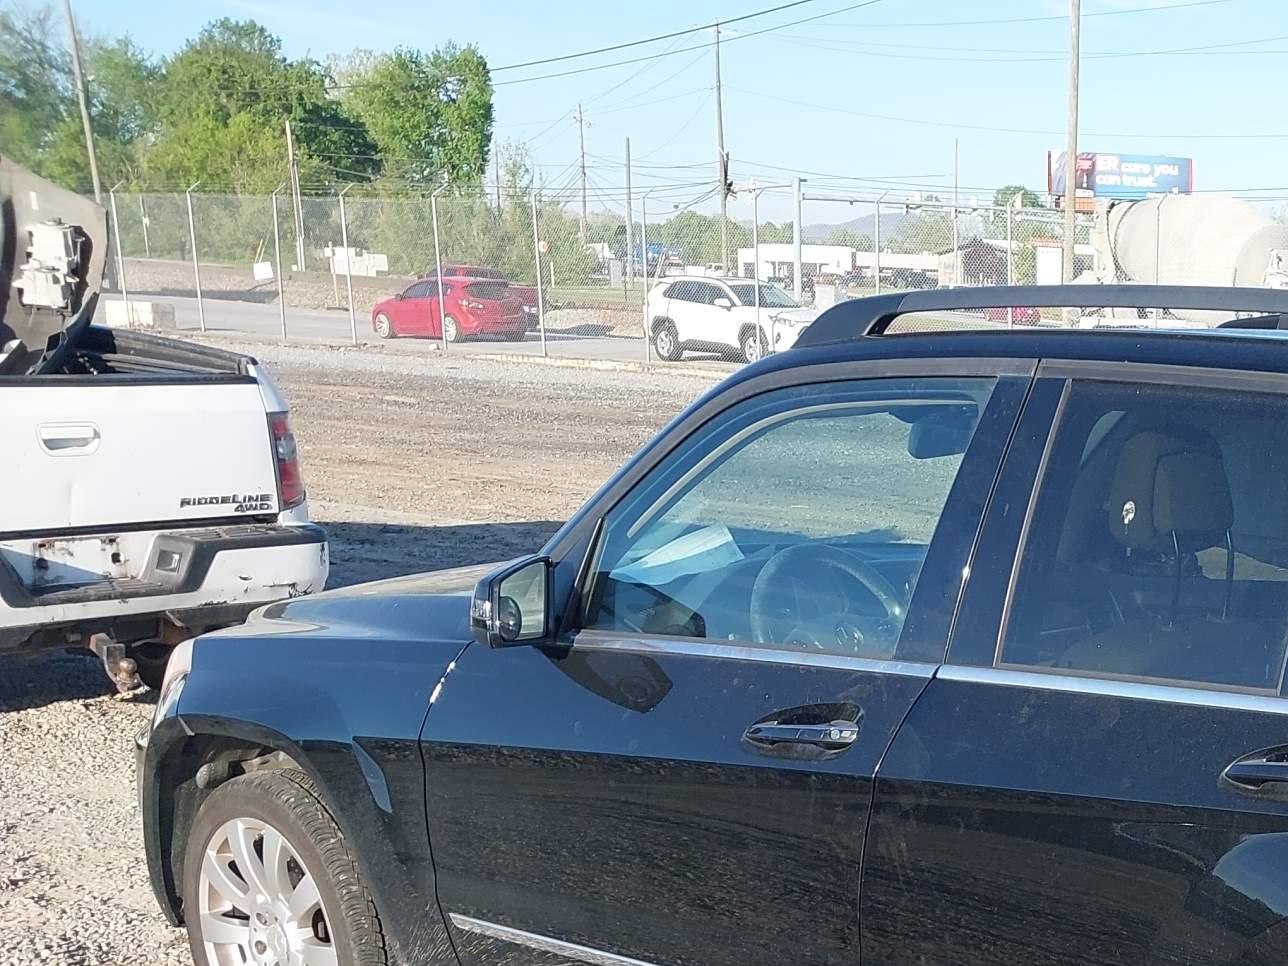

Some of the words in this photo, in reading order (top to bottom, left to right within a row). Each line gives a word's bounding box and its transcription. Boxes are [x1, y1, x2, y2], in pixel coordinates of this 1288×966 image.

[1097, 155, 1119, 171] ER
[1121, 162, 1151, 174] care
[1153, 163, 1179, 177] you
[1096, 174, 1121, 185] can
[234, 503, 273, 513] 4WD
